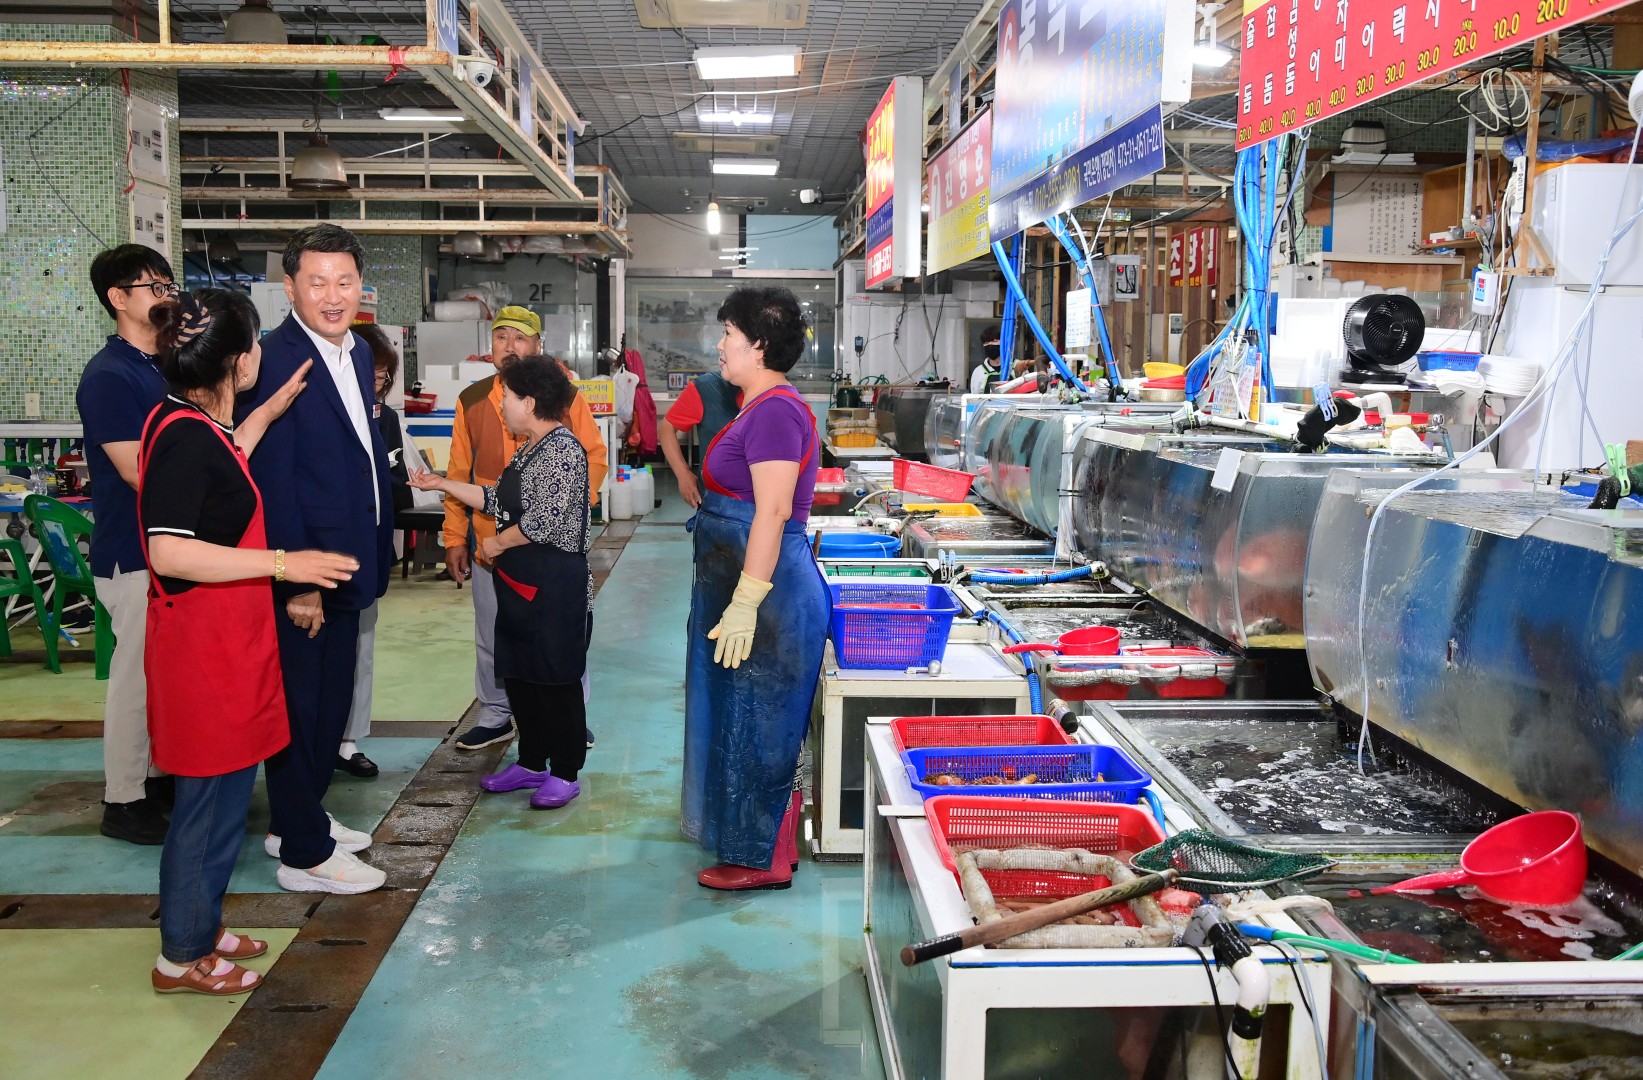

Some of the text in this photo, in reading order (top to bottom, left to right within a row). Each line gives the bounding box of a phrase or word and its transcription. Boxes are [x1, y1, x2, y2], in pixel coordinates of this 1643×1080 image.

[1239, 0, 1569, 143] 60.0 40.0 40.0 40.0 40.0 30.0 30.0 30.0 20.0 10.0 20.0
[945, 144, 984, 208] 진영호
[529, 283, 552, 302] 2F
